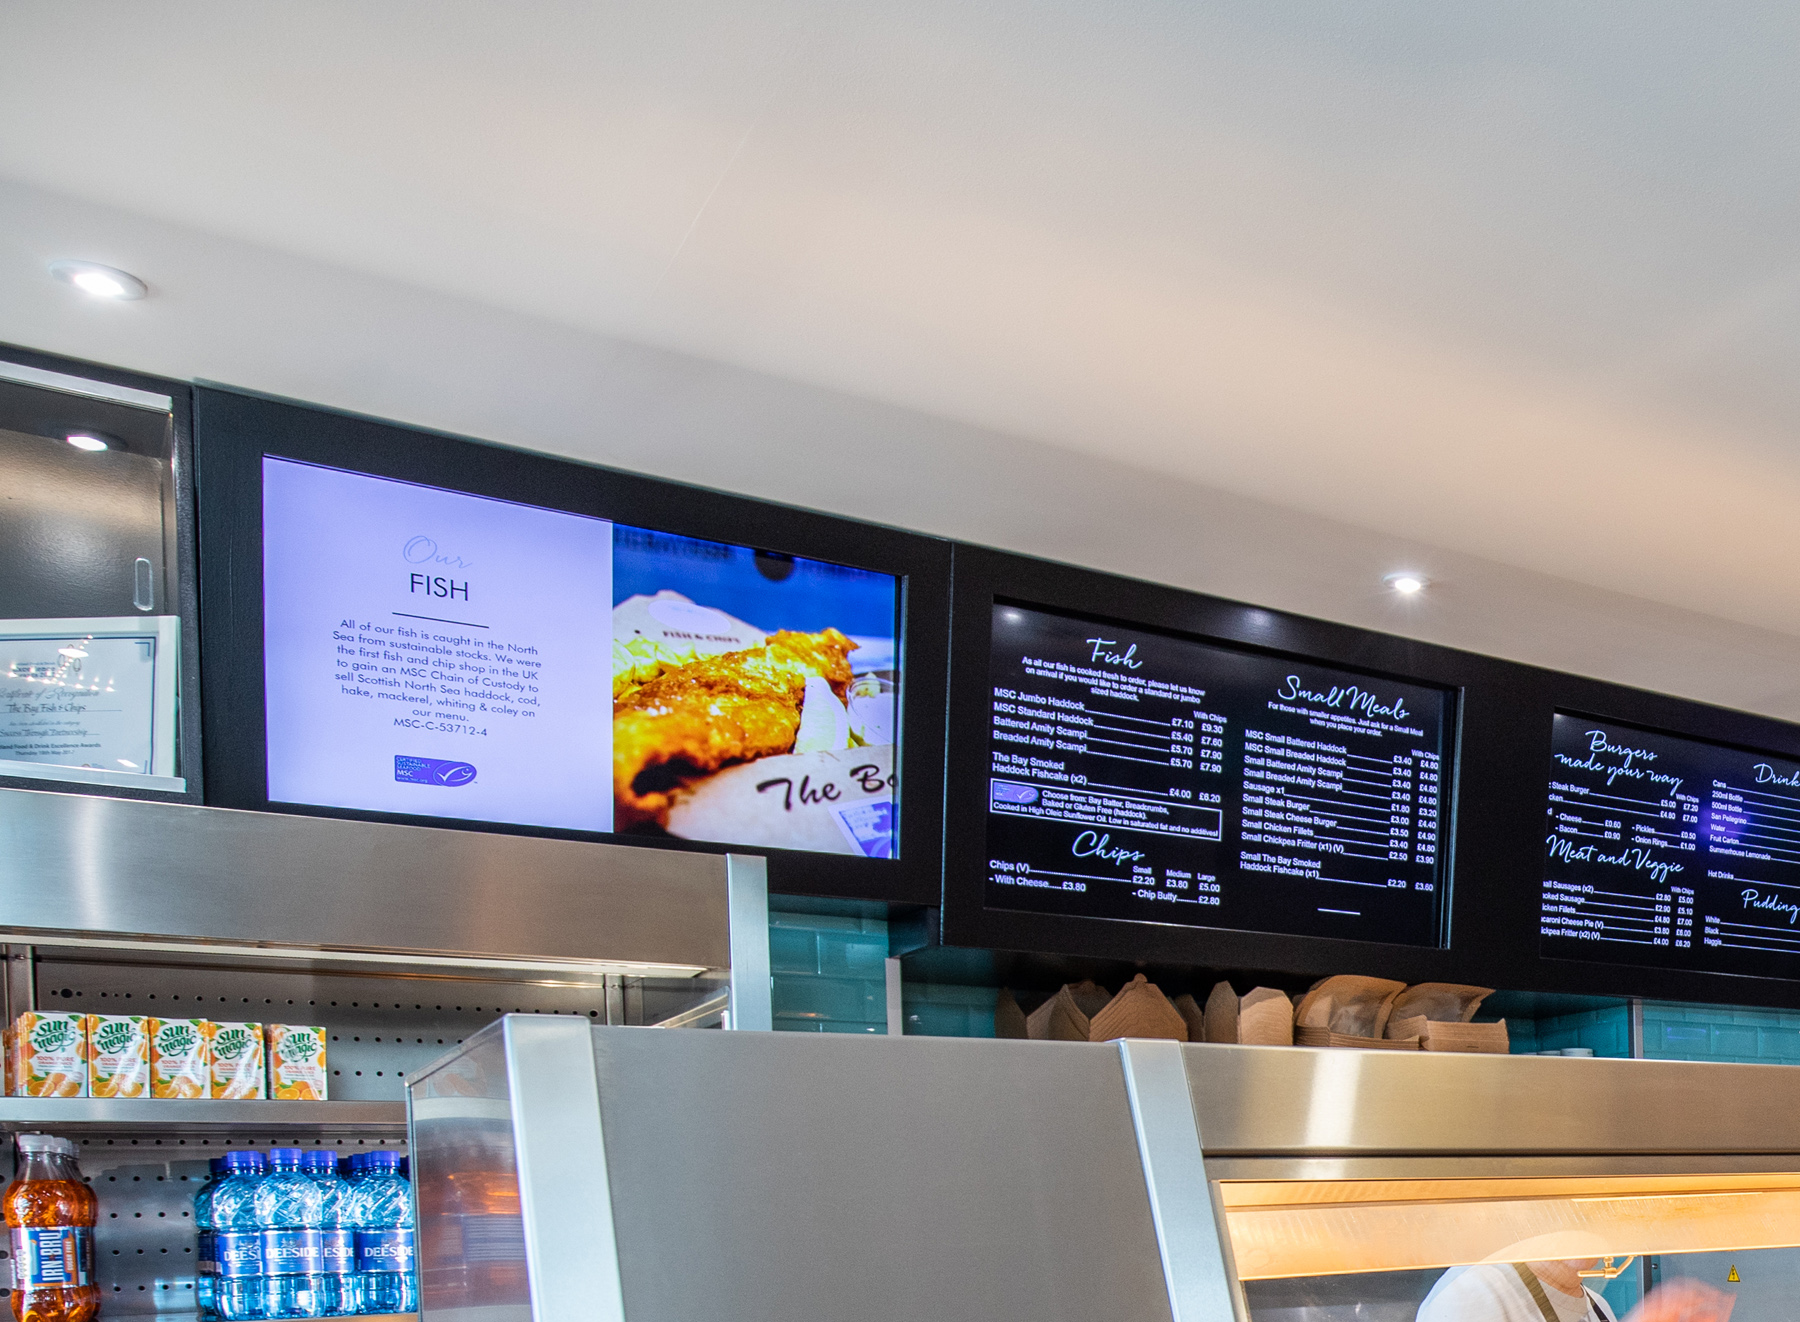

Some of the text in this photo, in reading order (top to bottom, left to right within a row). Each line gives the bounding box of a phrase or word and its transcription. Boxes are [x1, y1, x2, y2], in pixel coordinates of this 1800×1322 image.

[403, 536, 472, 568] Our
[411, 573, 468, 601] FISH
[332, 630, 542, 668] Sea from sustainable stocks. We were
[340, 619, 538, 655] All of our fish is caught in the North
[1086, 638, 1143, 669] Fish
[336, 658, 539, 693] to gain an MSC Chain of Custody to
[337, 644, 538, 680] the first fish and chip shop in the UK
[334, 671, 540, 707] sell Scottish North Sea haddock, cod,
[341, 684, 373, 699] hake,
[377, 692, 432, 706] mackerel,
[436, 697, 476, 712] whiting
[479, 702, 487, 711] &
[490, 704, 518, 717] coley
[1278, 675, 1410, 719] Small Meals
[393, 718, 487, 736] MSC-C-53712-4
[412, 709, 469, 722] our menu.
[994, 687, 1223, 734] MSC Jumbo Haddock £7.10 £9.30
[994, 701, 1223, 747] MSC Standard Haddock £5.40 £7.60
[993, 730, 1222, 773] Breaded Amity Scampi £5.70 £7.90
[994, 715, 1222, 760] Battered Amity Scampi £5.70 £7.90
[1245, 729, 1439, 770] MSC Small Battered Haddock £3.40 £4.80
[1585, 730, 1658, 768] Burgers
[992, 751, 1065, 770] The Bay Smoked
[1554, 753, 1684, 796] made your way
[757, 775, 841, 811] The
[992, 762, 1221, 803] Haddock Fishcake (x2) £4.00 £6.20
[1072, 831, 1145, 865] Chips
[1546, 834, 1684, 883] Meat and Veggie
[989, 859, 1220, 892] Chips (V) £2.20 £3.80 £5.00
[995, 874, 1086, 892] With Cheese £3.80
[1133, 865, 1216, 883] Small Medium Large
[1137, 889, 1220, 906] Chip Butty £2.80
[33, 1031, 75, 1053] magic
[37, 1020, 69, 1036] sun
[97, 1032, 137, 1054] magic
[99, 1021, 130, 1038] sun
[159, 1025, 190, 1041] sun
[216, 1029, 245, 1045] sun
[158, 1035, 197, 1057] magic
[214, 1039, 251, 1060] magic
[266, 1247, 319, 1258] DEESIDE
